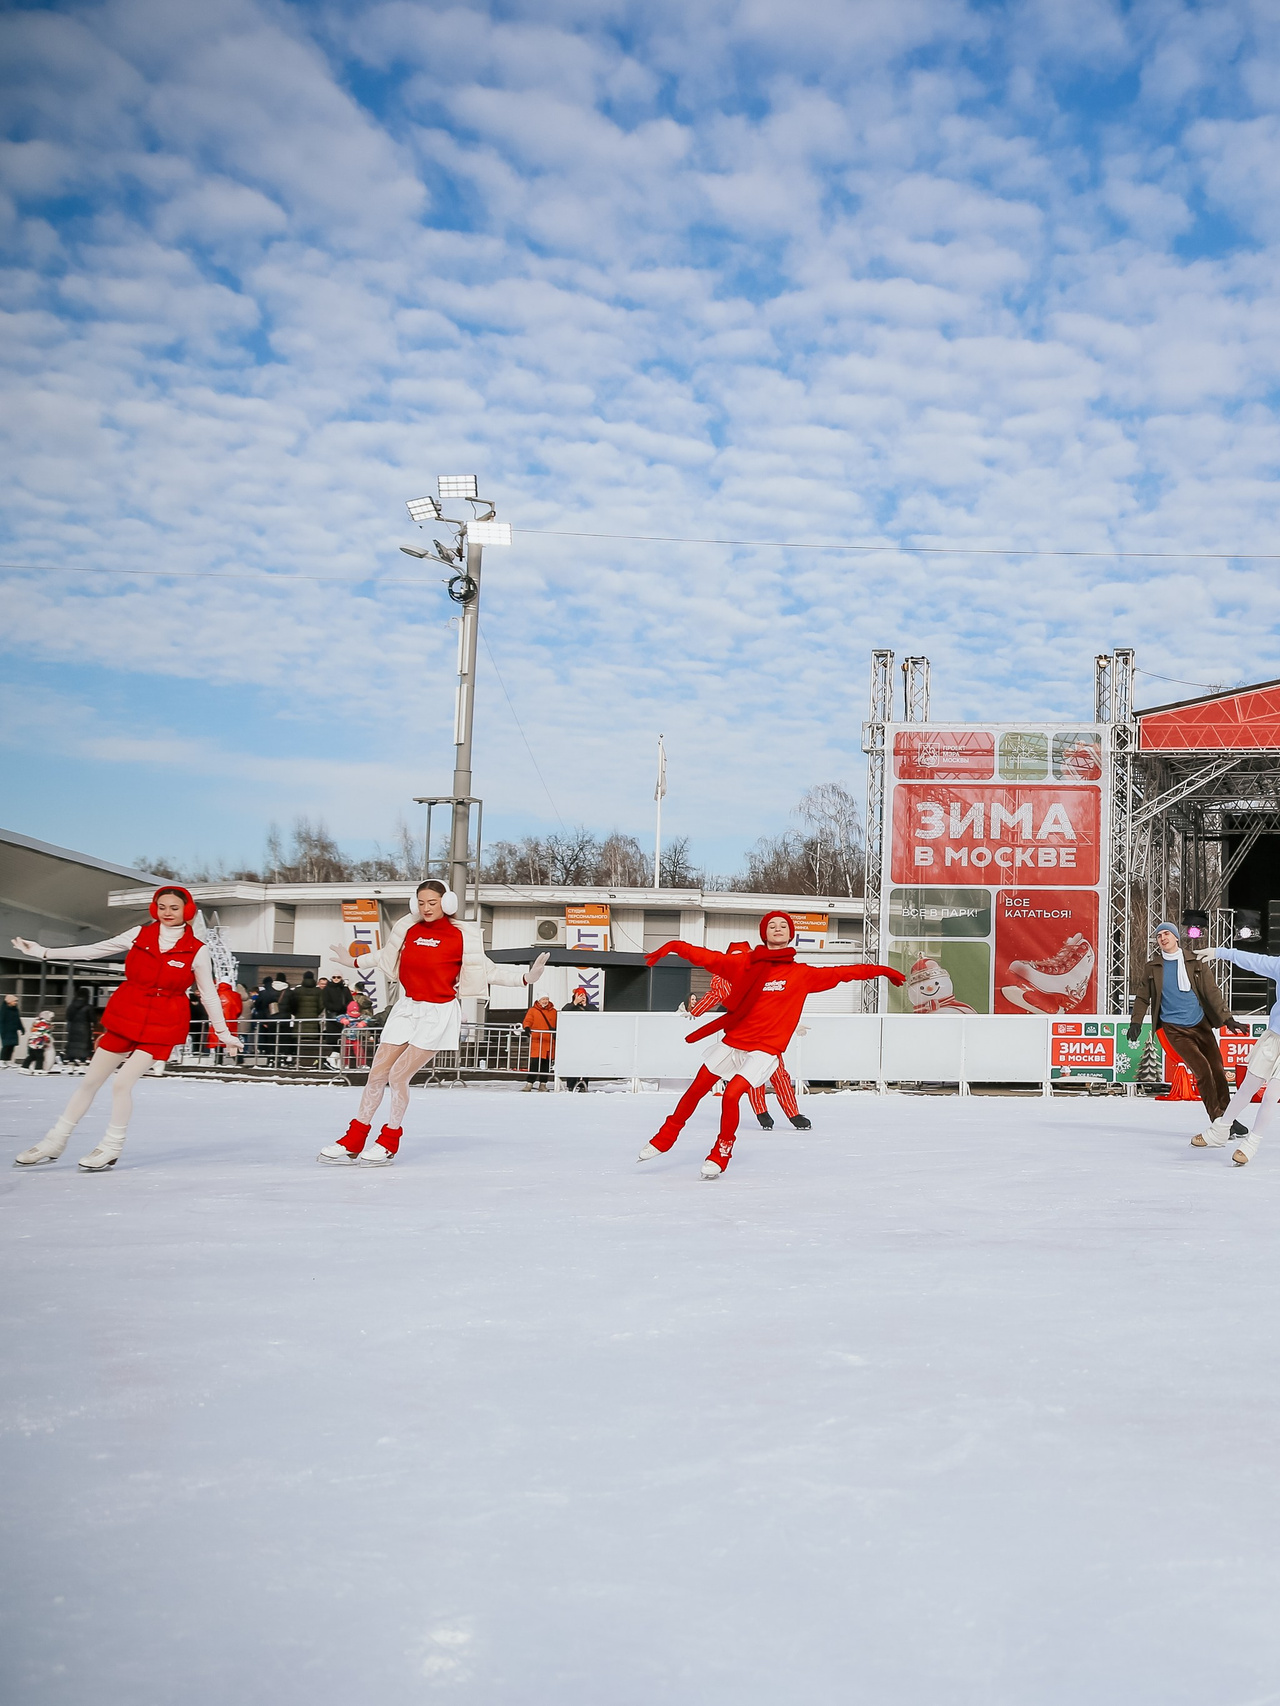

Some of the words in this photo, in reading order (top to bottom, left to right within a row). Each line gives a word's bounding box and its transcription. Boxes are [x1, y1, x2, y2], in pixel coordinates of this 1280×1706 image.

[914, 801, 1077, 840] ЗИМА
[914, 846, 934, 867] В
[944, 846, 1077, 868] МОСКВЕ
[1005, 898, 1030, 907] ВСЕ
[902, 908, 926, 918] ВСЕ
[930, 908, 938, 918] В
[941, 909, 978, 918] ПАРК!
[1005, 909, 1073, 918] КАТАТЬСЯ!
[1059, 1042, 1106, 1054] ЗИМА
